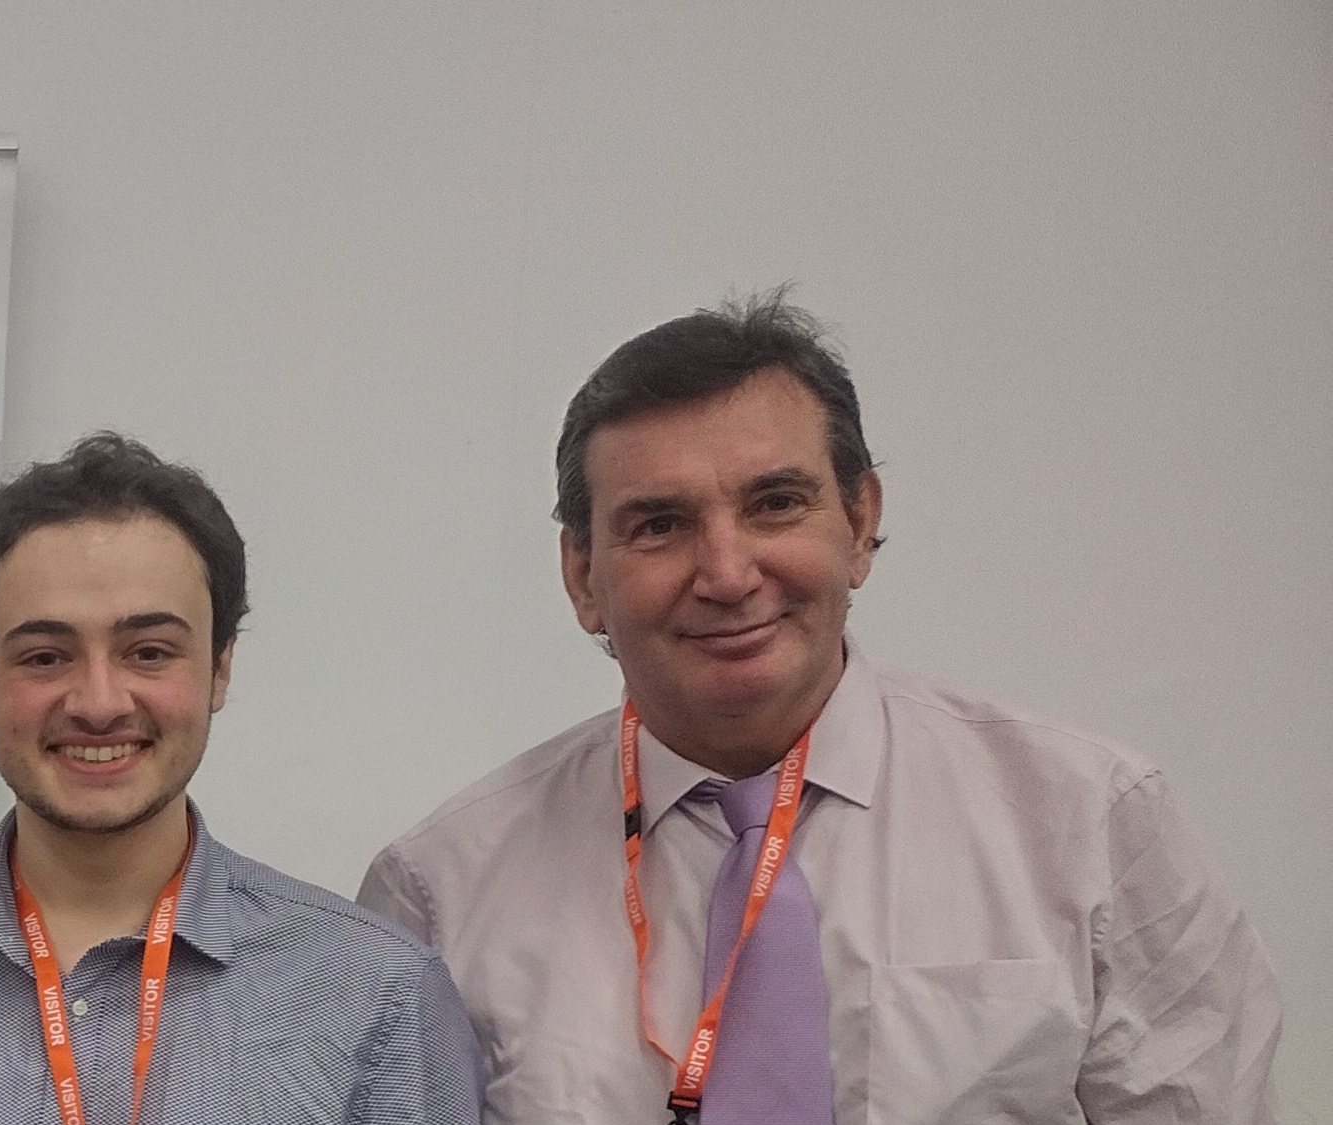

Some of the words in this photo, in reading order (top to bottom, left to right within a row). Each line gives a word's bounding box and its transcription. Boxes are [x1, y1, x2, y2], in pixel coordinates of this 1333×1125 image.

[776, 747, 802, 808] VISITOR
[753, 835, 785, 898] VISITOR
[23, 912, 50, 959] VISITOR
[152, 895, 176, 946] VISITOR
[43, 985, 66, 1047] VISITOR
[141, 977, 161, 1043] VISITOR
[682, 1027, 714, 1090] VISITOR
